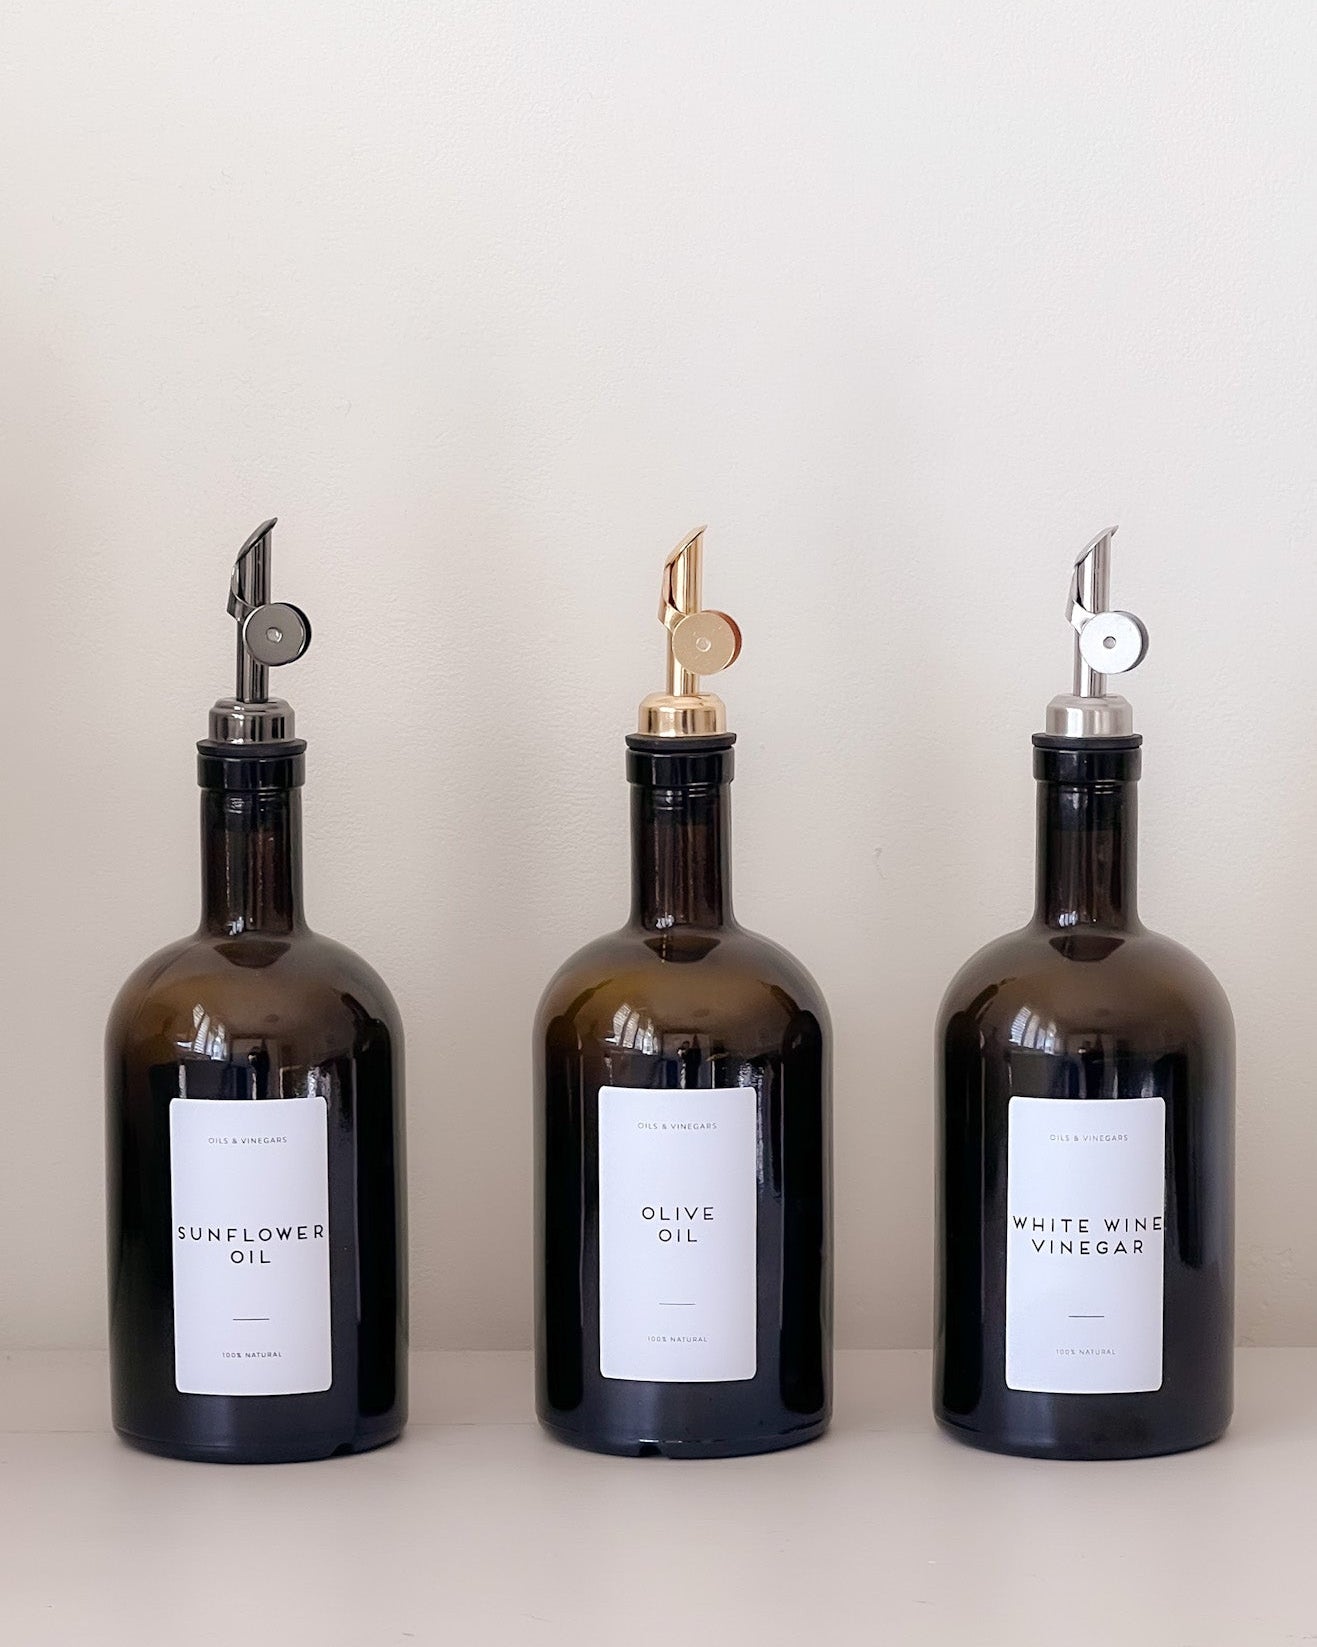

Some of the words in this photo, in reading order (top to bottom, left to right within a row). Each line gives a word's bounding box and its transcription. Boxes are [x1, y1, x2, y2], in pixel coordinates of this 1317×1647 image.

[637, 1122, 658, 1130] OILS
[670, 1122, 718, 1130] VINEGARS
[208, 1136, 229, 1145] OILS
[231, 1137, 238, 1145] &
[241, 1136, 288, 1145] VINEGARS
[1049, 1134, 1071, 1142] OILS
[1073, 1134, 1080, 1142] &
[1083, 1134, 1129, 1142] VINEGARS
[641, 1206, 715, 1221] OLIVE
[1012, 1215, 1090, 1233] WHITE
[1104, 1216, 1163, 1232] WINE
[177, 1224, 325, 1242] SUNFLOWER
[658, 1228, 698, 1243] OIL
[1031, 1239, 1144, 1255] VINEGAR
[230, 1250, 271, 1264] OIL
[245, 1351, 283, 1359] NATURAL
